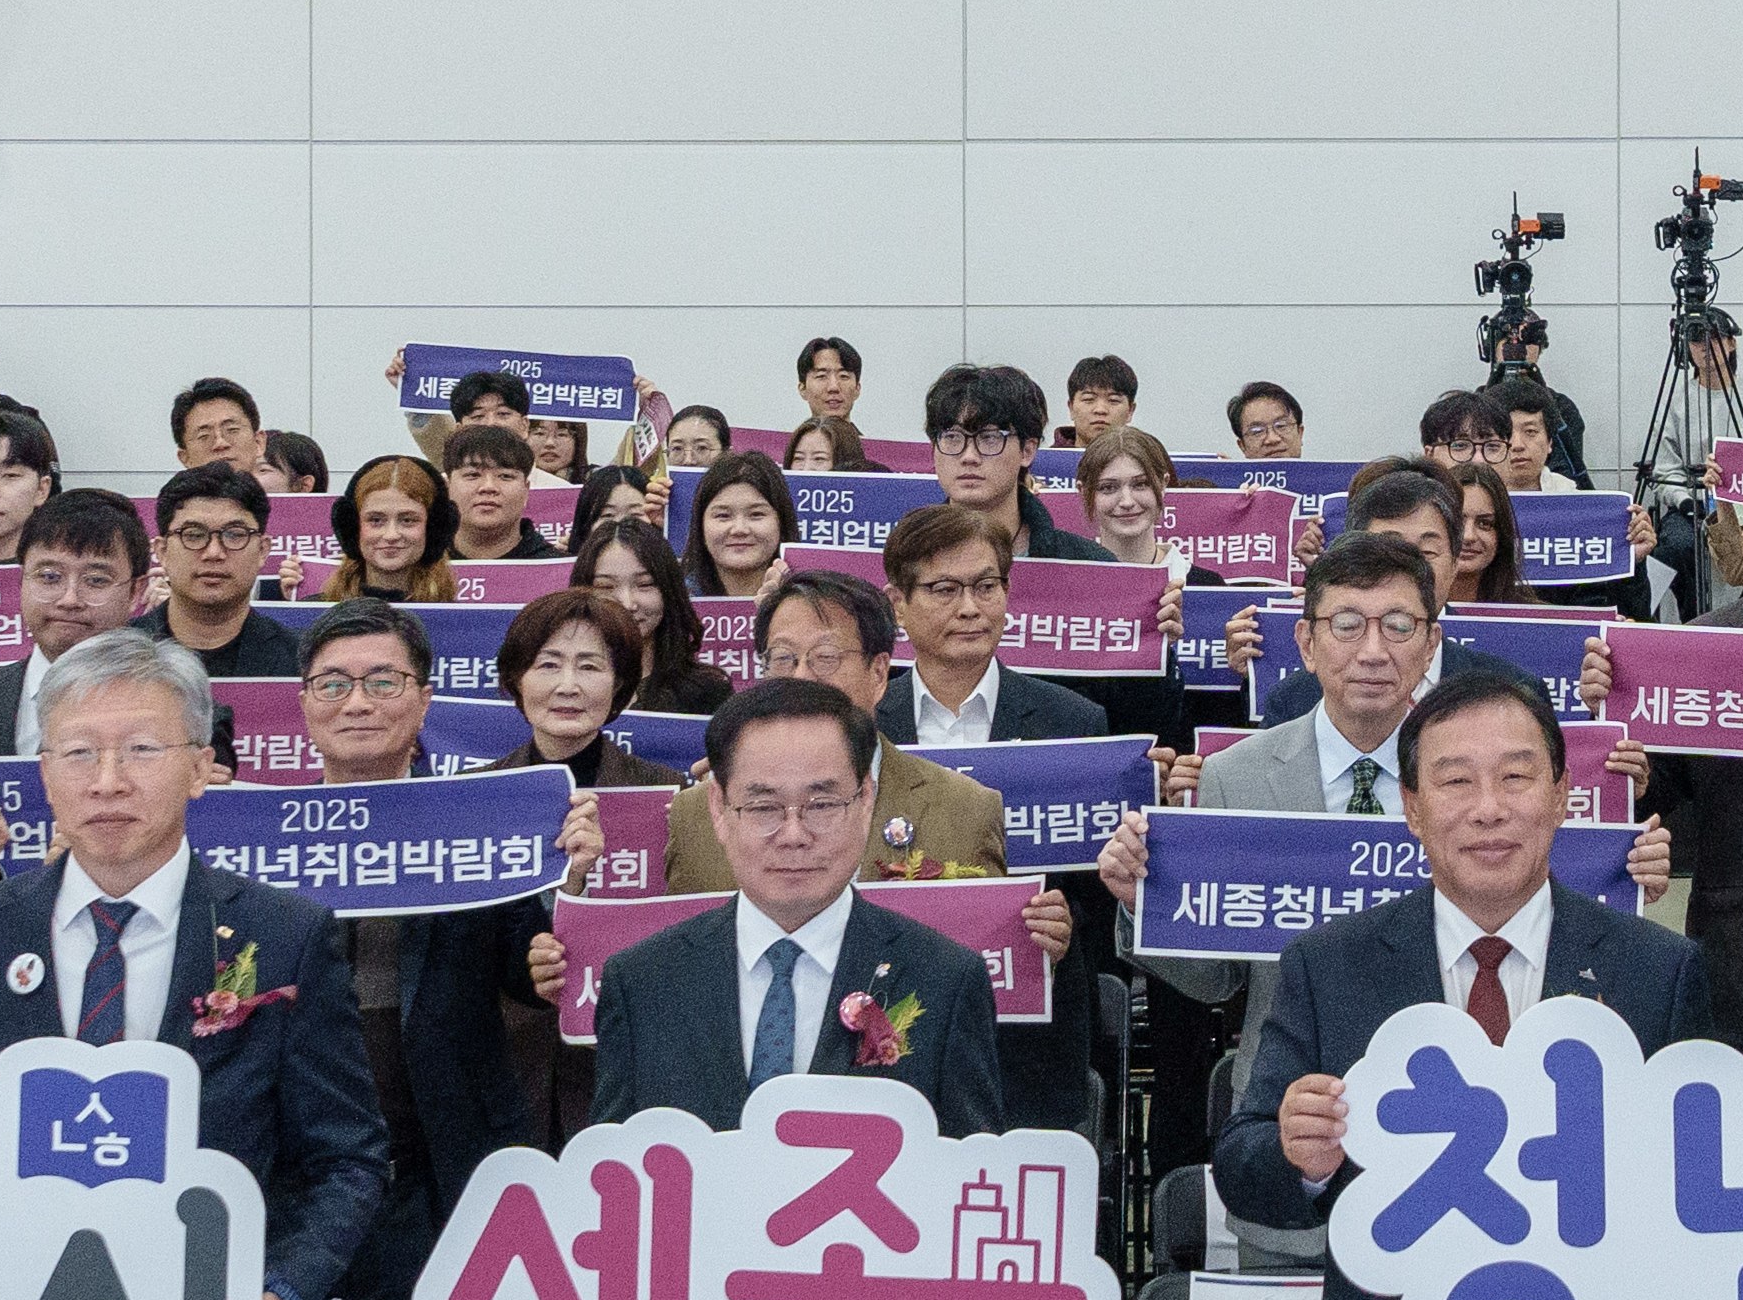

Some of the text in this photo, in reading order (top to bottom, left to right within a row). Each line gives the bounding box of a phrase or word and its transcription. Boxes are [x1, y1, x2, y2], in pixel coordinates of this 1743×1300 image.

[499, 358, 543, 380] 2025
[797, 489, 855, 514] 2025
[281, 797, 371, 834] 2025
